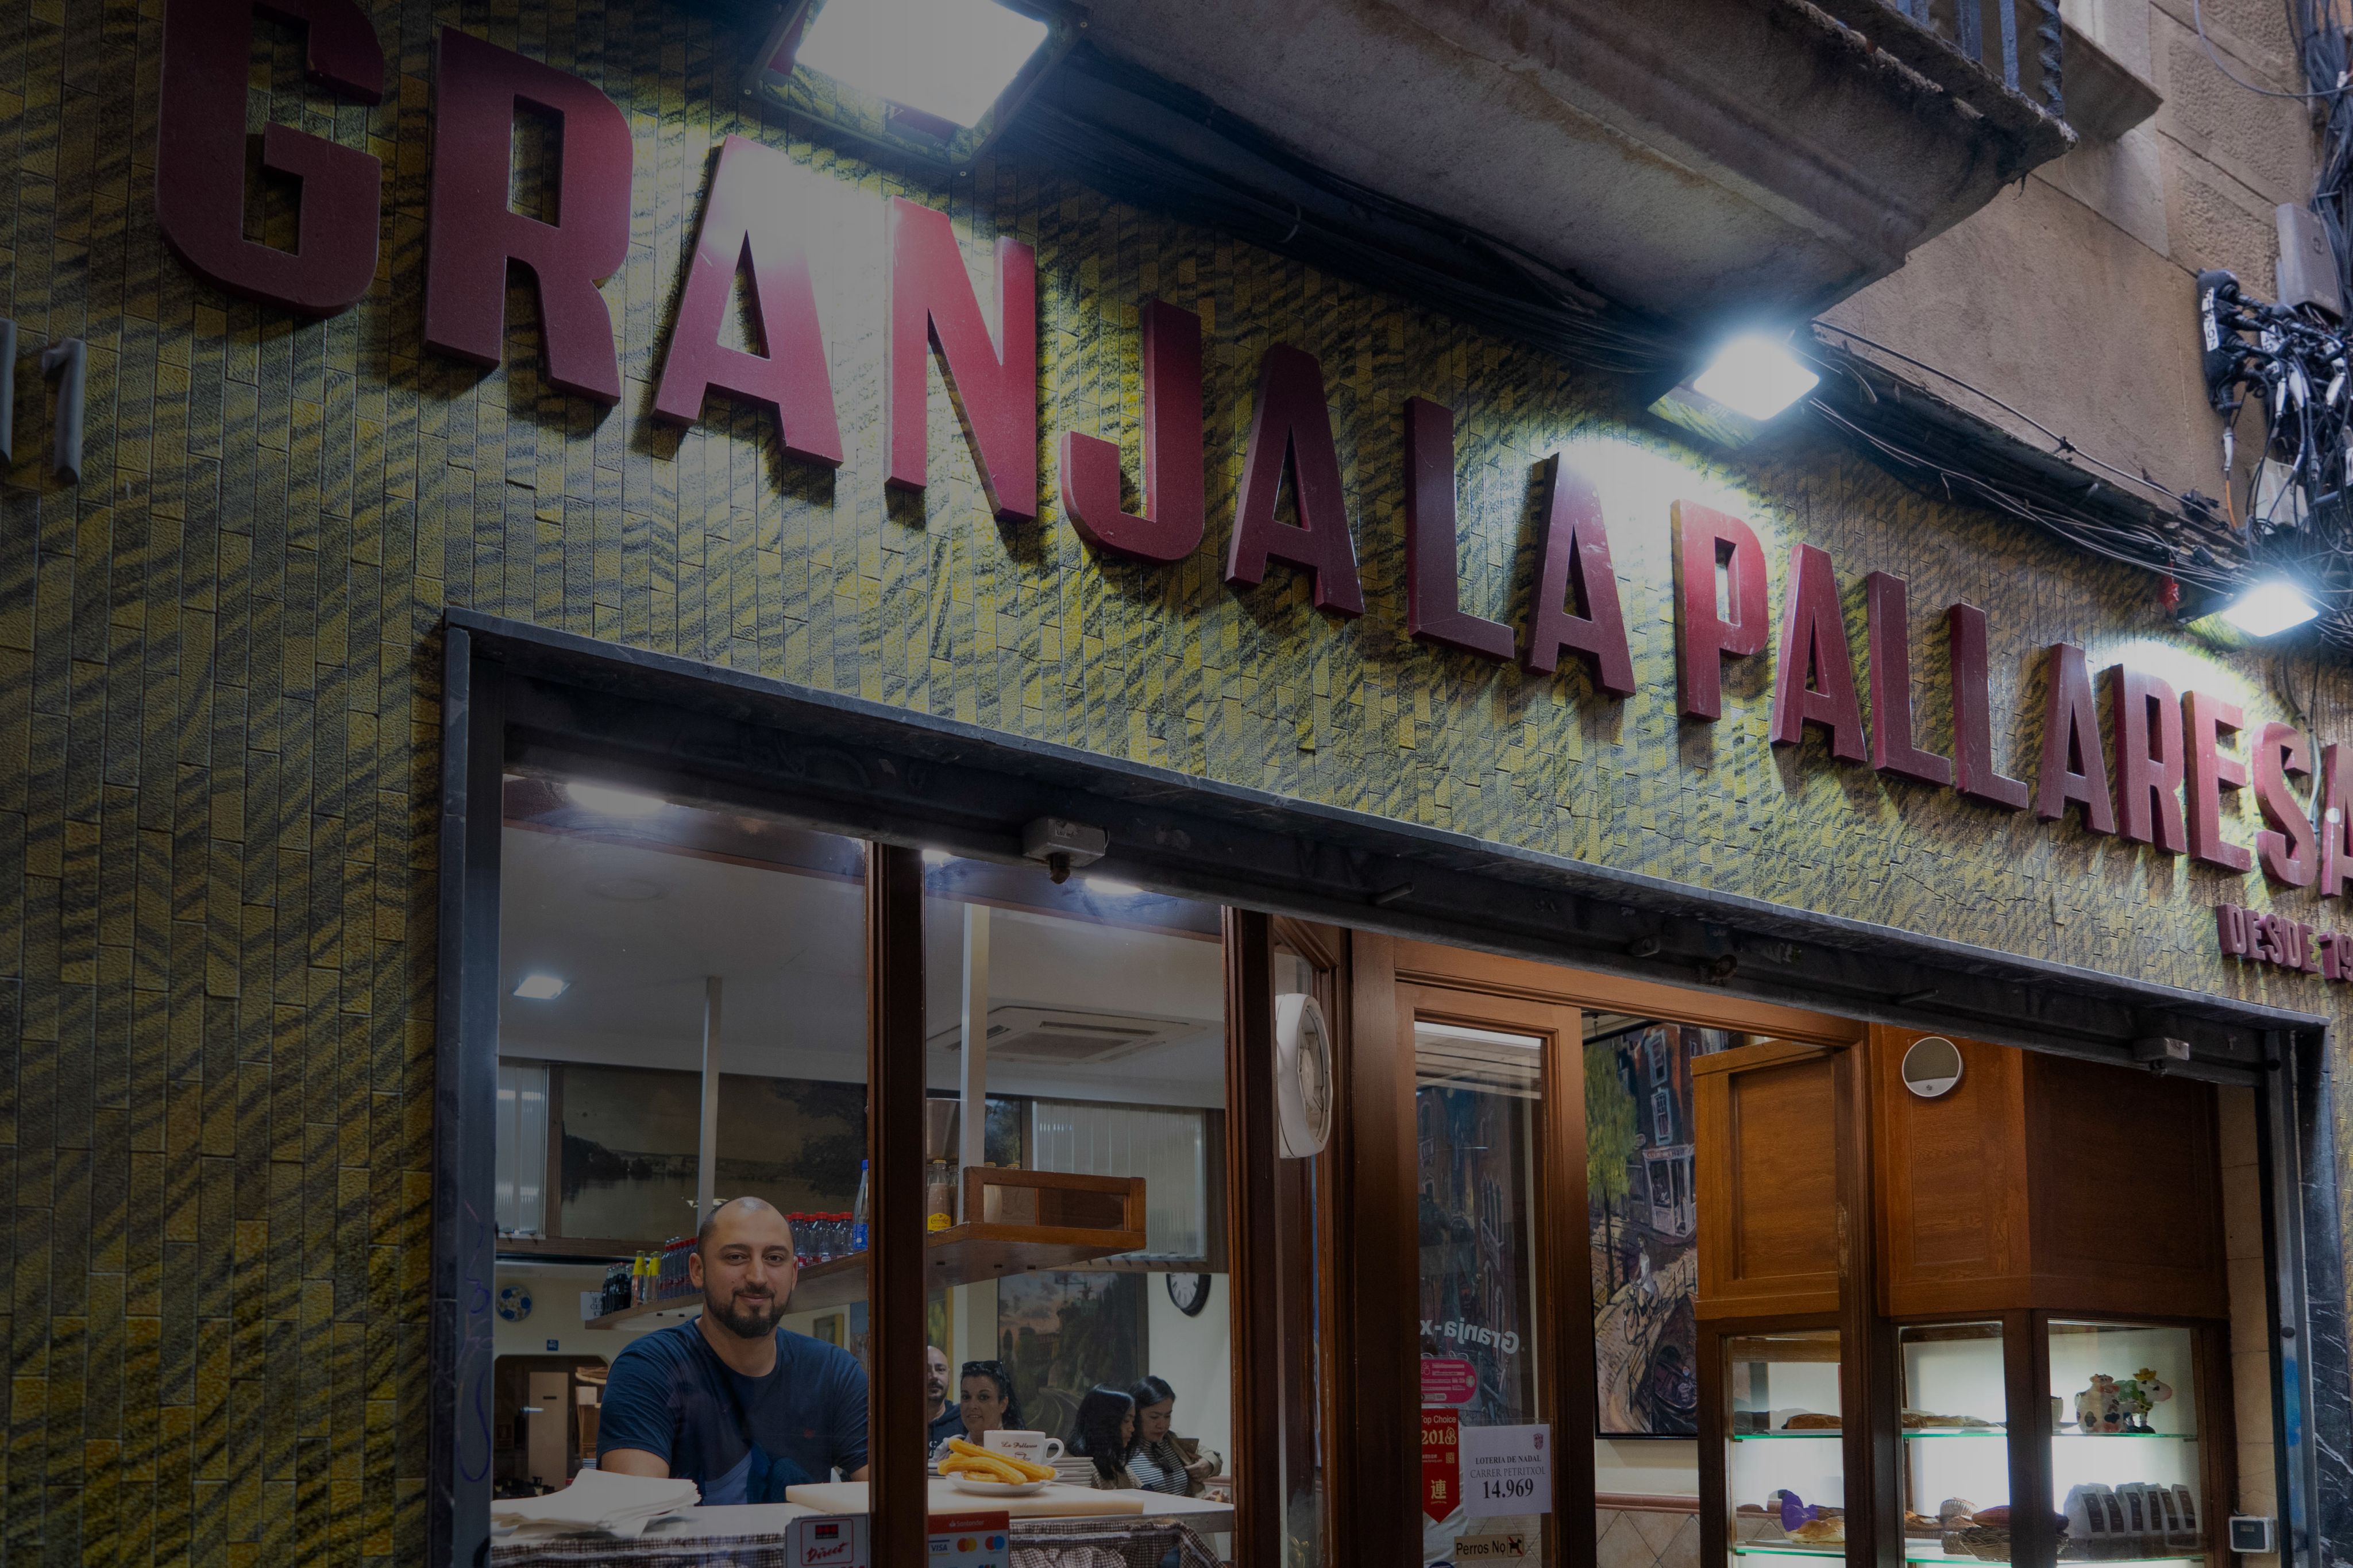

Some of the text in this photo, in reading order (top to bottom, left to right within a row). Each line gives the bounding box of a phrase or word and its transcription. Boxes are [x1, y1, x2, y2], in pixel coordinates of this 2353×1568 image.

[156, 0, 1365, 619] GRANJA
[1403, 395, 1636, 698] LA
[2216, 902, 2320, 975] DESDE
[1433, 1415, 1456, 1423] Choice
[1422, 1426, 1457, 1445] 2018
[1476, 1457, 1506, 1465] LOTERIA
[1470, 1466, 1546, 1478] CARRER PETRITXOL
[1482, 1478, 1534, 1499] 14.969
[1456, 1540, 1506, 1555] Perros No
